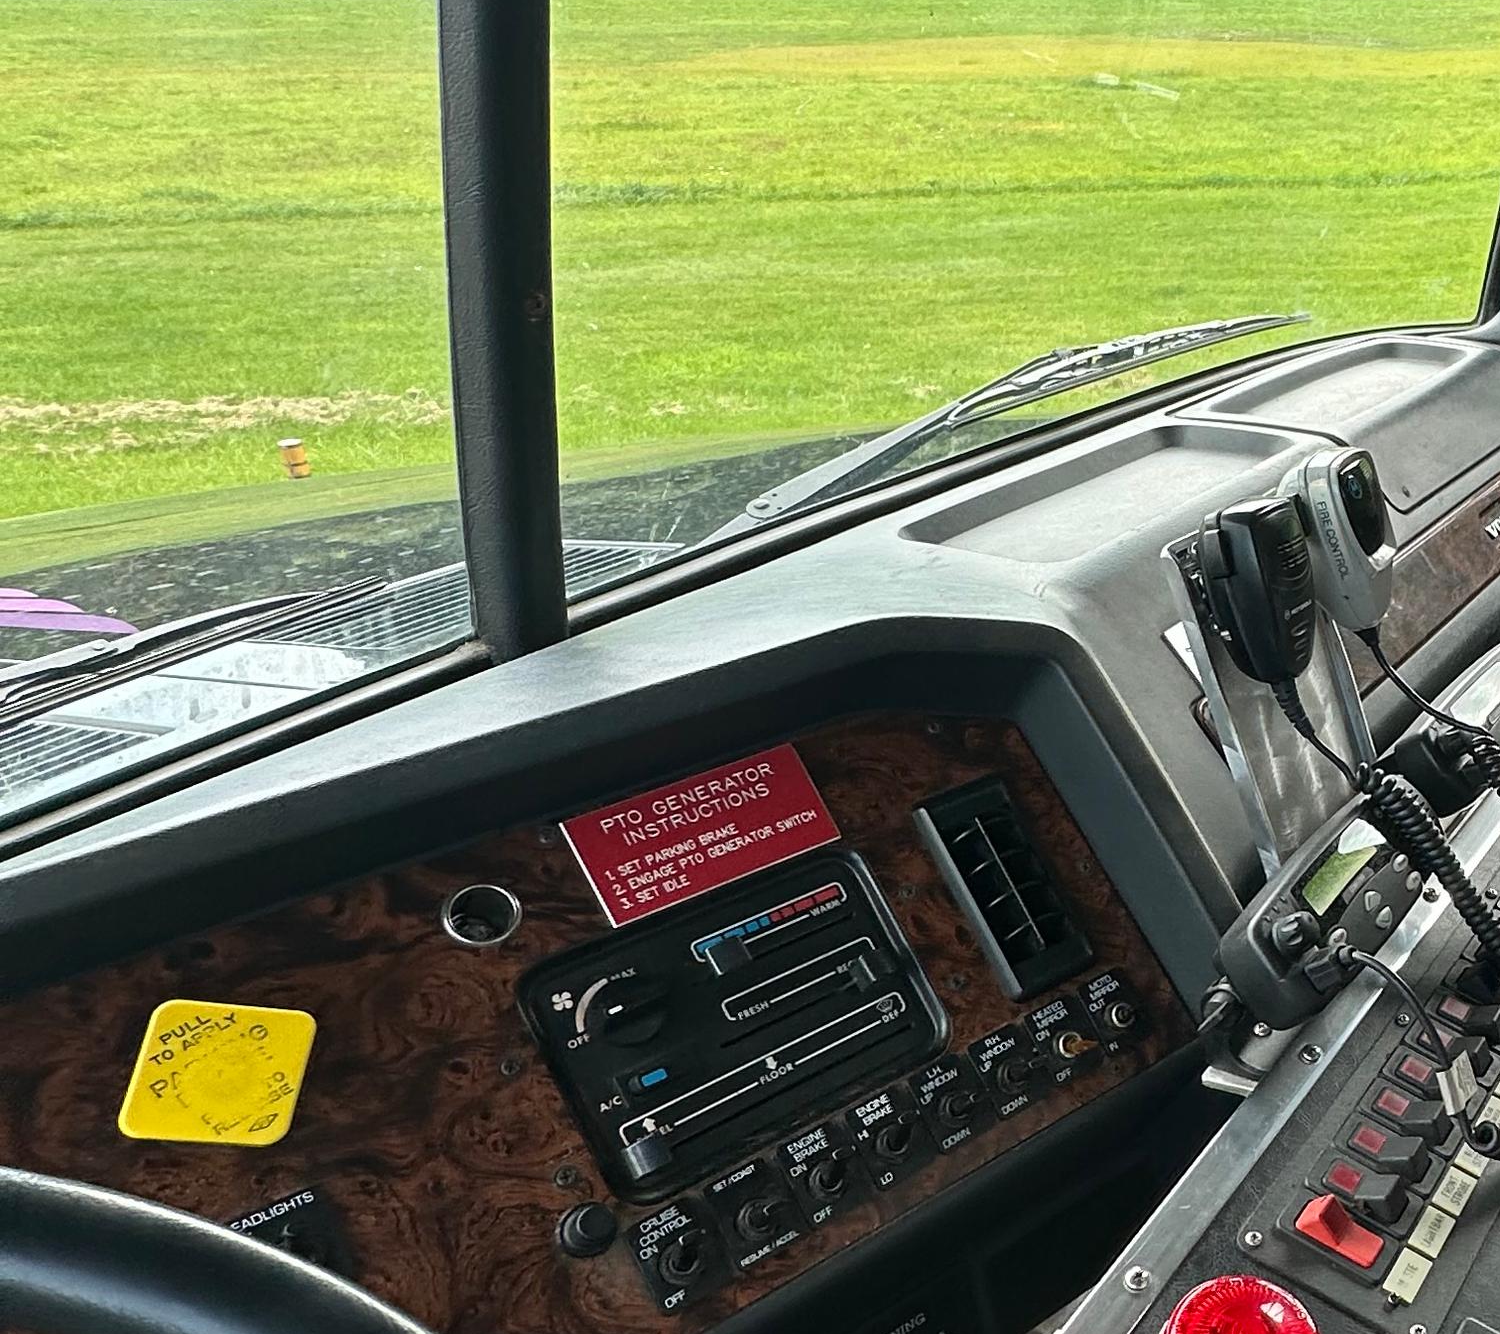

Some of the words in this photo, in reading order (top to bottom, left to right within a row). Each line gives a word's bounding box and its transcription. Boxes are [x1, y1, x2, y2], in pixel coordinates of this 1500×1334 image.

[1316, 501, 1333, 530] FIRE
[1325, 528, 1350, 580] CONTROL
[600, 809, 642, 834] PTO
[652, 762, 775, 815] GENERATOR
[622, 782, 770, 847] INSTRUCTIONS
[617, 860, 641, 877] SET
[645, 840, 697, 867] PARKING
[699, 823, 740, 845] BRAKE
[629, 863, 678, 890] ENGAGE
[680, 852, 705, 870] PTO
[707, 826, 776, 859] GENERATOR
[777, 809, 818, 833] SWITCH
[635, 886, 660, 903] SET
[662, 874, 692, 893] IDLE
[809, 899, 842, 917] WARM
[610, 968, 637, 982] MAX
[737, 1000, 770, 1021] FRESH
[1031, 1000, 1065, 1021] HEATED
[1089, 998, 1107, 1013] OUT
[1036, 1008, 1069, 1030] MIRROR
[159, 1015, 211, 1046] PULL
[1036, 1029, 1050, 1043] ON
[566, 1034, 592, 1050] OFF
[979, 1037, 1016, 1063] WINDOW
[149, 1049, 175, 1066] TO
[979, 1060, 993, 1074] UP
[759, 1062, 794, 1086] FLOOR
[920, 1068, 958, 1094] WINDOW
[1055, 1067, 1073, 1083] OFF
[600, 1095, 623, 1113] A/C
[855, 1093, 891, 1118] ENGINE
[919, 1092, 935, 1106] UP
[1001, 1094, 1029, 1116] DOWN
[862, 1103, 895, 1127] BRAKE
[786, 1128, 827, 1154] ENGINE
[857, 1129, 870, 1142] HI
[942, 1127, 972, 1150] DOWN
[792, 1137, 830, 1164] BRAKE
[789, 1162, 808, 1178] ON
[880, 1171, 895, 1186] LO
[230, 1191, 315, 1232] EADLIGHTS
[639, 1205, 680, 1233] CRUISE
[813, 1205, 834, 1224] OFF
[639, 1215, 692, 1248] CONTROL
[639, 1244, 659, 1260] ON
[664, 1289, 687, 1309] OFF
